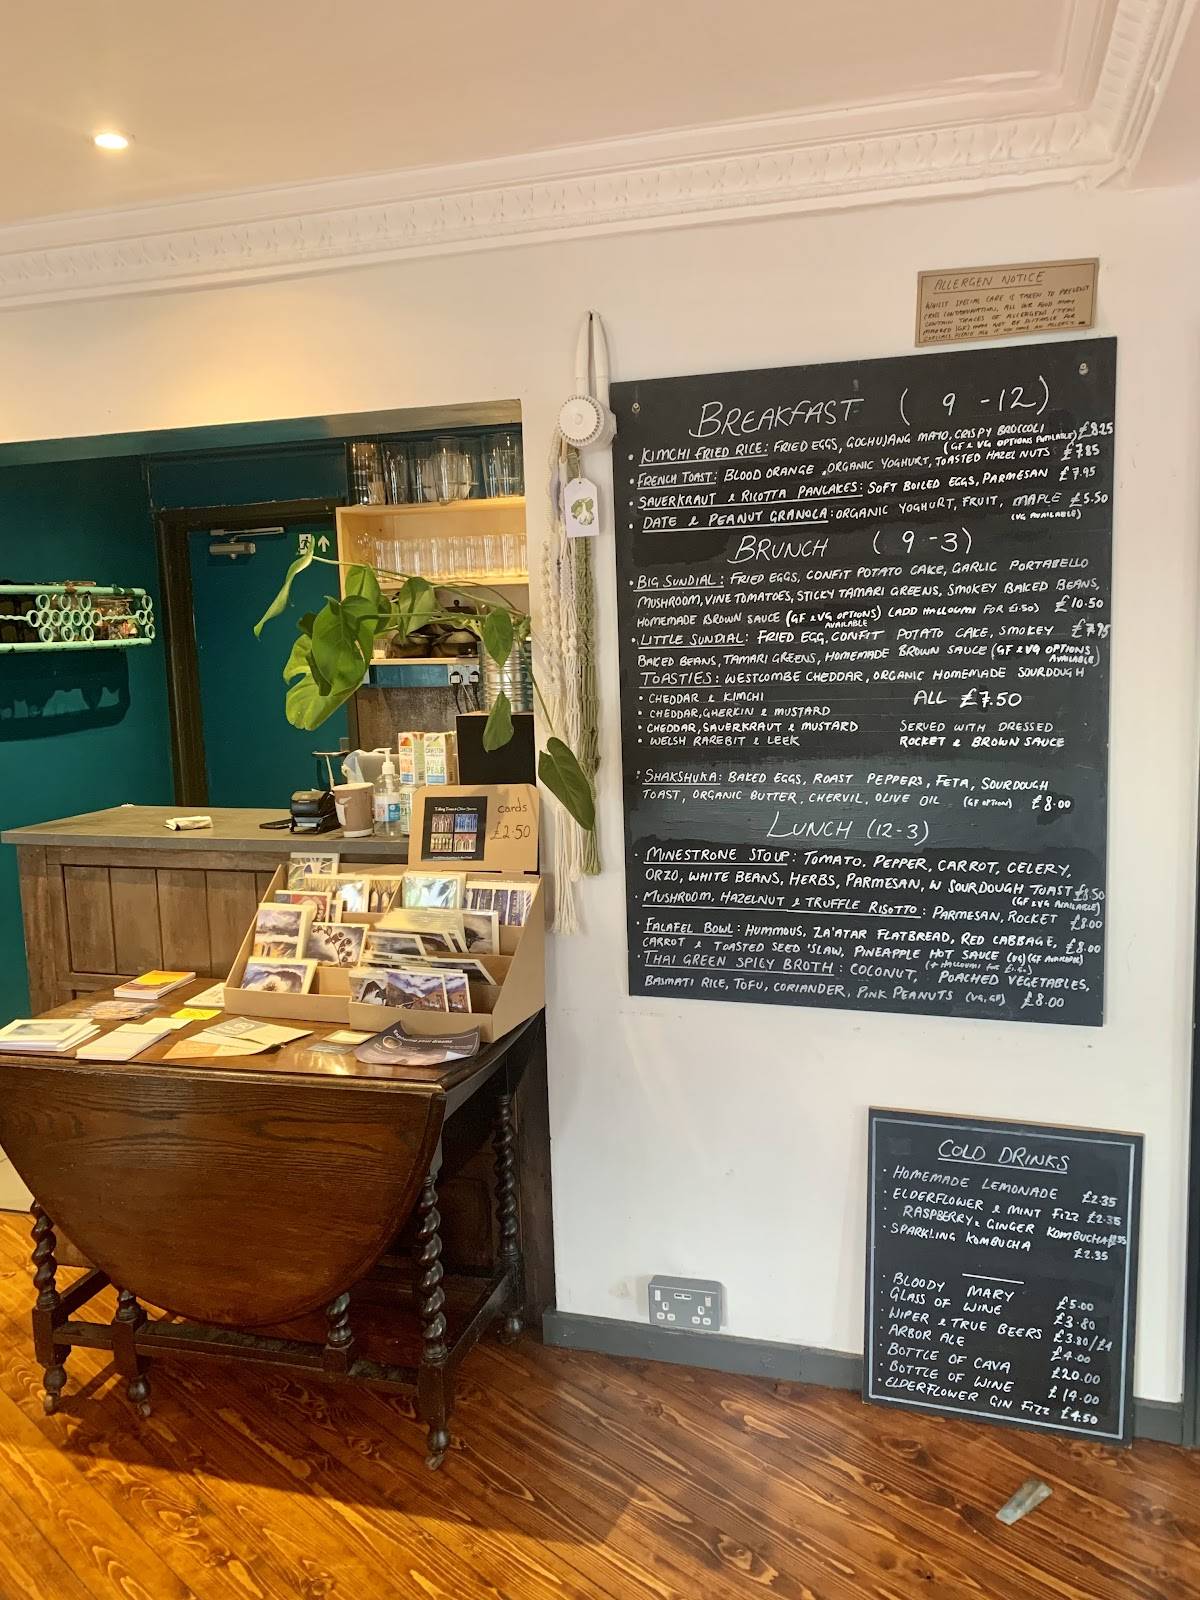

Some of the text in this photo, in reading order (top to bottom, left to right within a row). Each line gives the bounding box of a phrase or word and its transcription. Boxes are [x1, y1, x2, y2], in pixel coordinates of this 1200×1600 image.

[934, 271, 1046, 290] ALLERGEN NOTICE
[689, 399, 864, 437] BREAKFAST
[641, 424, 1044, 464] KIMCHI FRIED RICE: FRIED EGGS, GOCHUJANG BROCCOLI
[637, 447, 1051, 487] FRENCH TOAST: BLOOD TOASTED NUTS
[638, 466, 1096, 509] SAUERKRAUT RICOTTA SOFT BOILED PARMESAN £7.95
[643, 492, 1108, 530] DATE PEANUT FRUIT, MAPLE £5.50
[727, 535, 829, 564] BRUNCH
[637, 559, 1089, 589] BIG FRIED EGGS, CONFIT POTATO CAKE, GARLIC PORTABELLO
[705, 582, 1048, 605] VINE STICKY TAMARI SMOKEY BAKED
[637, 595, 1103, 628] HOMEMADE BROWN SAUCE HALLOUMI FOR £10.50
[825, 620, 867, 629] AVAILABLE
[640, 625, 1054, 646] LITTLE FRIED CONFIT POTATO SMOKEY
[638, 644, 987, 667] BAKED TAMARI BROWN SAUCE
[725, 668, 1006, 684] WESTCOMBE ORGANIC HOMEMADE
[649, 692, 764, 704] CHEDDAR KIMCHI
[775, 706, 831, 718] MUSTARD
[913, 688, 1022, 708] ALL £7.50
[801, 721, 858, 732] MUSTARD
[900, 720, 1053, 732] SERVED WITH DRESSED
[650, 735, 800, 746] WELSH RAREBIT LEEK
[900, 736, 1065, 748] ROCKET BROWN SAUCE
[728, 772, 1049, 791] BAKED ROAST FETA, SOURDOUGH
[498, 797, 528, 815] cards
[643, 789, 940, 806] TOAST, ORGANIC OLIVE OIL
[767, 811, 853, 839] LUNCH
[646, 847, 1072, 878] MINESTRONE CARROT, CELERY,
[646, 868, 1073, 896] ORZO, WHITE HERBS, SOURDOUGH TOAST
[721, 891, 1057, 924] HAZELNUT TRUFFLE ROCKET
[646, 917, 984, 945] FALAFEL ZA'ATAR RED
[714, 941, 999, 960] TOASTED SEED HOT SAUCE
[644, 951, 999, 985] THAI GREEN SPICY POACHED
[645, 975, 1064, 1009] BASMATI RICE, TOFU, PINK PEANUTS £8.00
[938, 1139, 1071, 1171] COLD DRINKS
[893, 1165, 1118, 1207] HOMEMADE LEMONADE £2.35
[893, 1188, 1080, 1222] ELDERFLOWER MINT FIZZ
[986, 1219, 1034, 1234] GINGER
[891, 1222, 1109, 1260] SPARKLING KOMBUCHA £2.35
[893, 1272, 1094, 1311] BLOODY MARY £5.00
[889, 1287, 1095, 1330] GLASS OF WINE £3.80
[951, 1318, 1043, 1339] TRUE BEERS
[889, 1324, 1091, 1364] ARBOR ALE £4.00
[888, 1343, 1101, 1384] BOTTLE OF CAVA £20.00
[885, 1377, 1012, 1408] ELDERFLOWER GIN
[974, 1376, 1015, 1393] WINE
